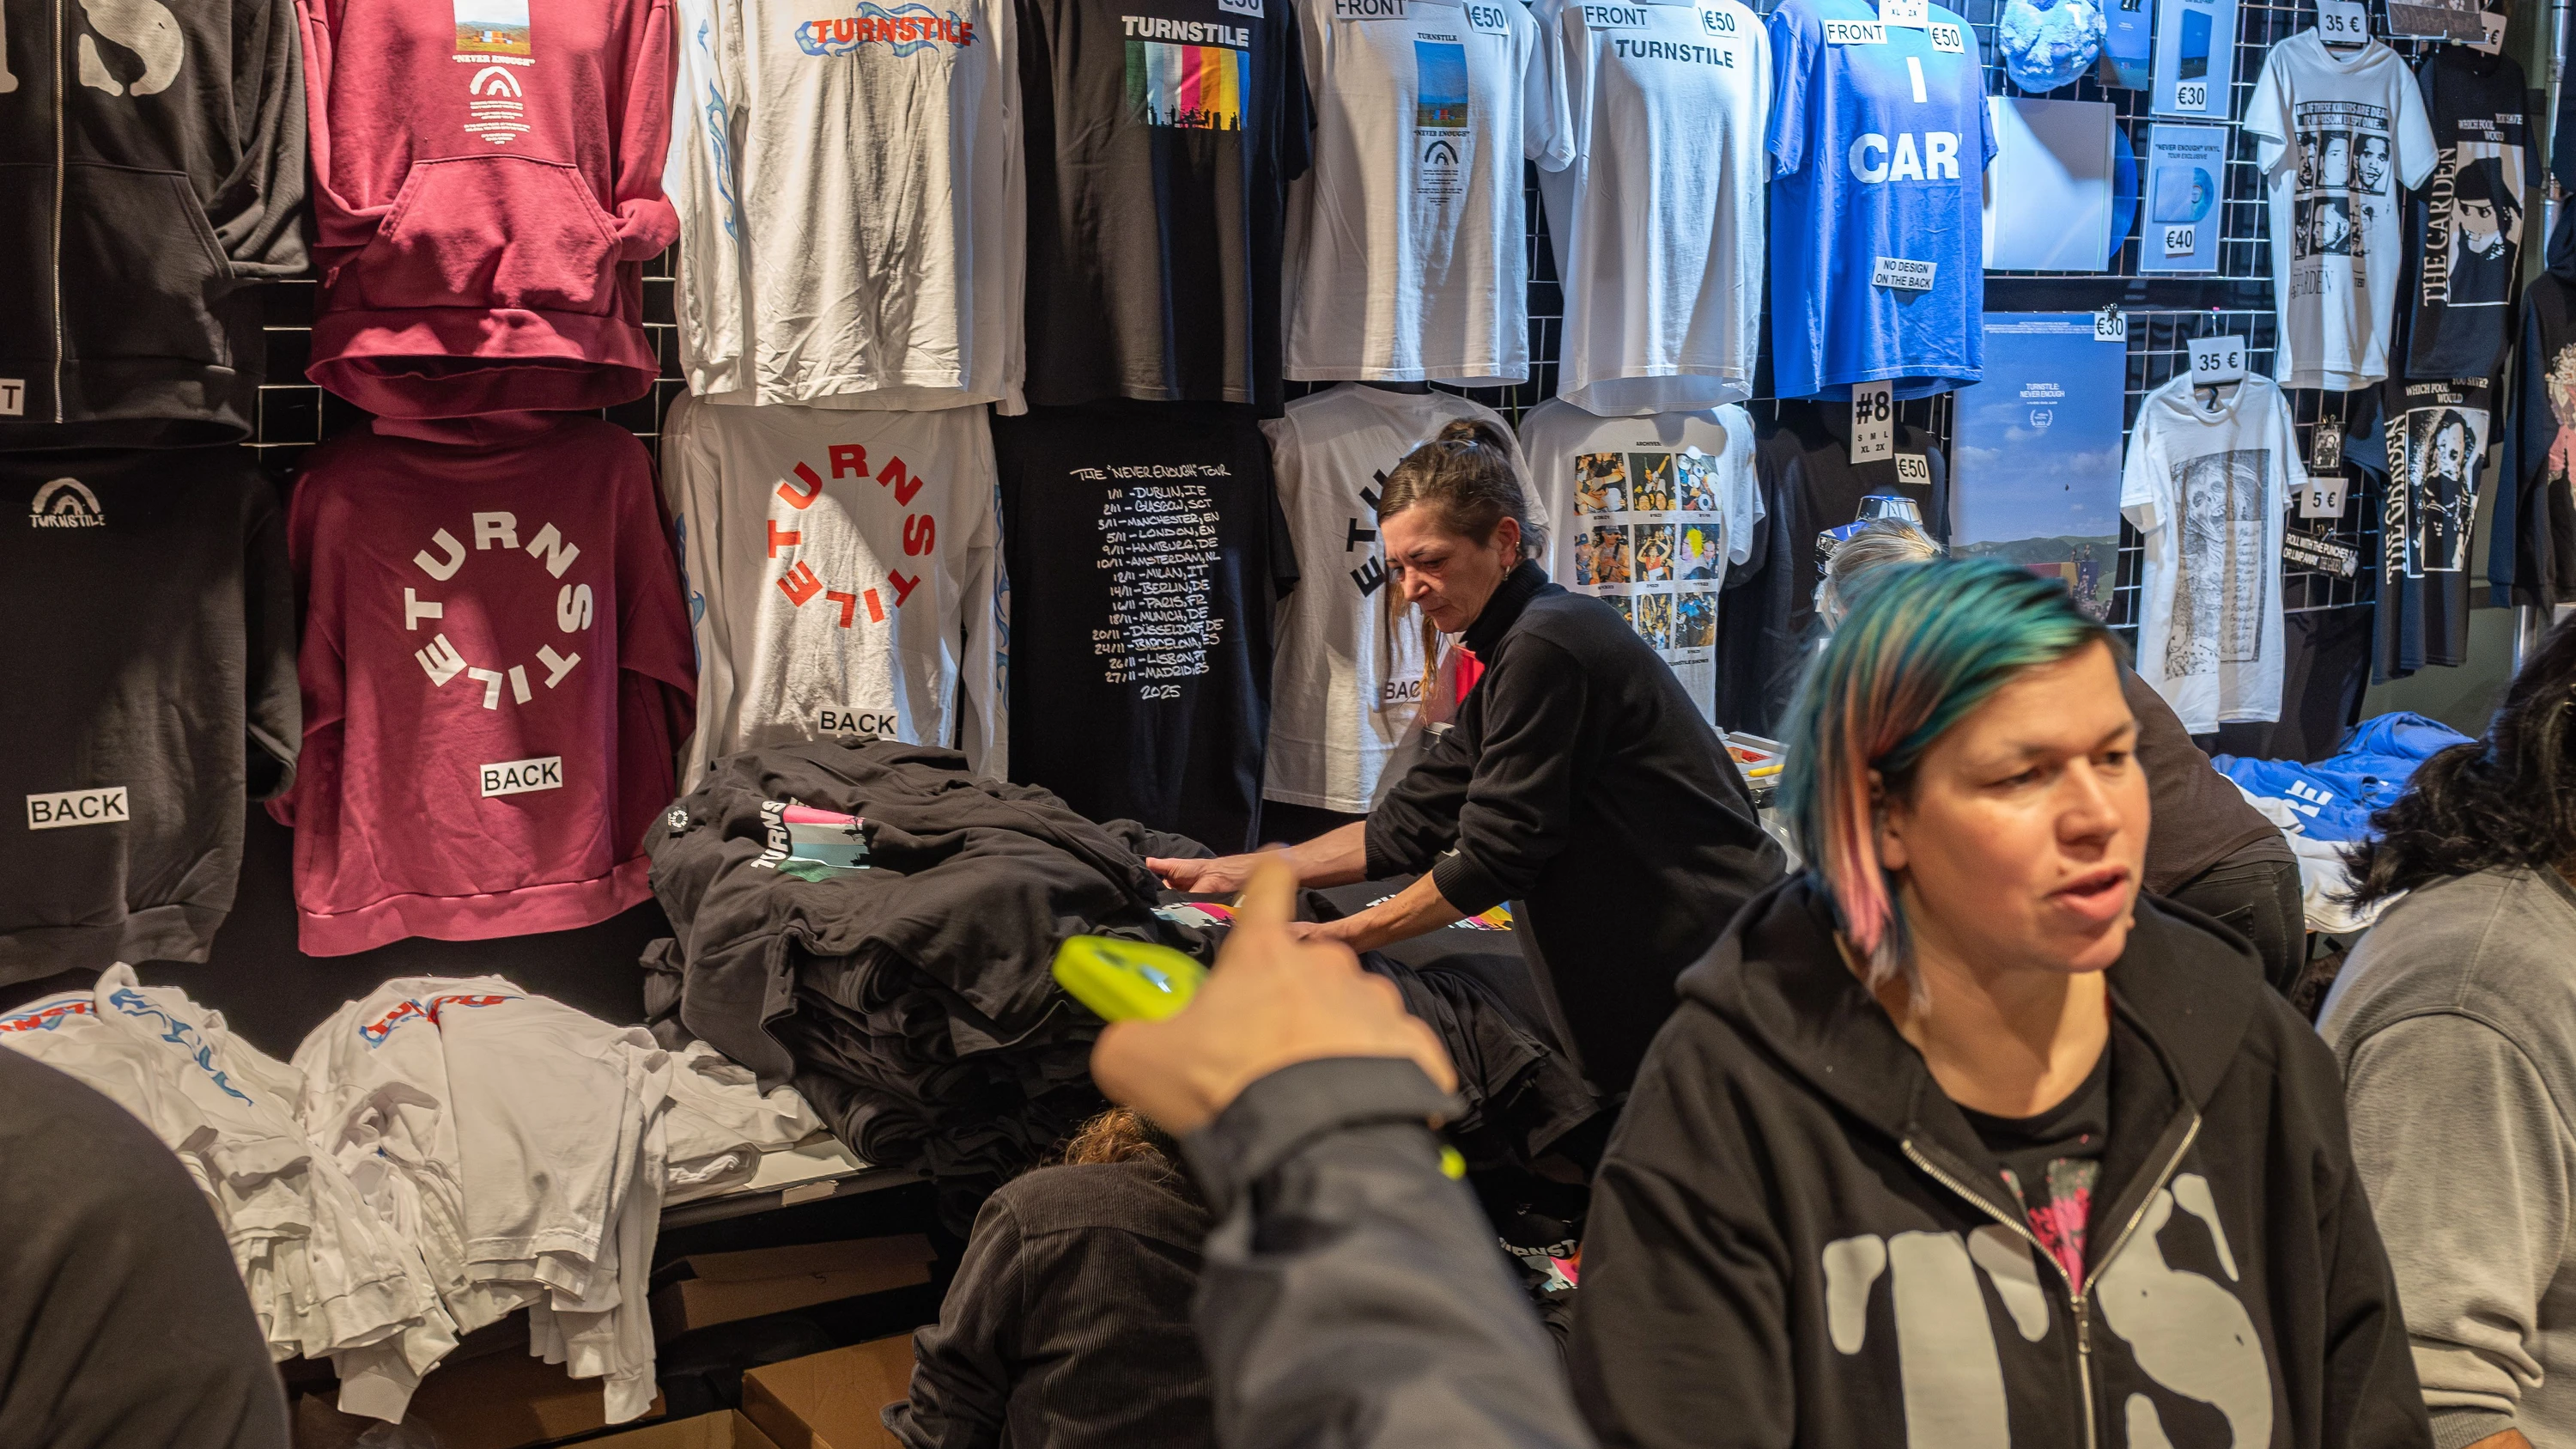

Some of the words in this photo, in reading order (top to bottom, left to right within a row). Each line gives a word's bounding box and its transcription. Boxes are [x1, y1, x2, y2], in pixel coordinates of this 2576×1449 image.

[1335, 0, 1404, 15] FRONT
[1471, 6, 1504, 28] €50
[1584, 6, 1648, 26] FRONT
[1704, 10, 1735, 32] €50
[2325, 15, 2344, 31] 35
[2349, 16, 2360, 33] €
[811, 16, 973, 47] TURNSTILE
[1121, 15, 1249, 47] TURNSTILE
[1418, 33, 1457, 41] TURNSTILE
[1827, 24, 1883, 40] FRONT
[1932, 27, 1959, 46] €50
[1616, 40, 1735, 69] TURNSTILE
[1906, 57, 1928, 103] I
[2178, 87, 2204, 105] €30
[1849, 131, 1962, 184] CAR
[2426, 147, 2457, 250] GARDEN
[2166, 230, 2192, 248] €40
[1883, 260, 1897, 271] NO
[1899, 262, 1929, 273] DESIGN
[1876, 273, 1889, 283] ON
[1891, 275, 1908, 286] THE
[1909, 277, 1931, 289] BACK
[2423, 254, 2447, 307] THE
[2097, 318, 2123, 335] €30
[2199, 353, 2221, 371] 35
[2227, 351, 2239, 368] €
[2406, 383, 2430, 396] WHICH
[2431, 383, 2450, 393] FOOL
[2437, 393, 2464, 404] WOULD
[1856, 391, 1890, 424] #8
[1070, 468, 1107, 481] THE
[1198, 464, 1231, 478] TOUR
[1899, 458, 1926, 478] €50
[2312, 492, 2322, 508] 5
[2327, 492, 2336, 508] €
[29, 514, 106, 528] TURNSTILE
[2286, 533, 2300, 547] ROLL
[1140, 685, 1181, 700] 2025
[1385, 680, 1421, 699] BAC
[821, 710, 896, 734] BACK
[484, 762, 560, 791] BACK
[32, 793, 125, 823] BACK
